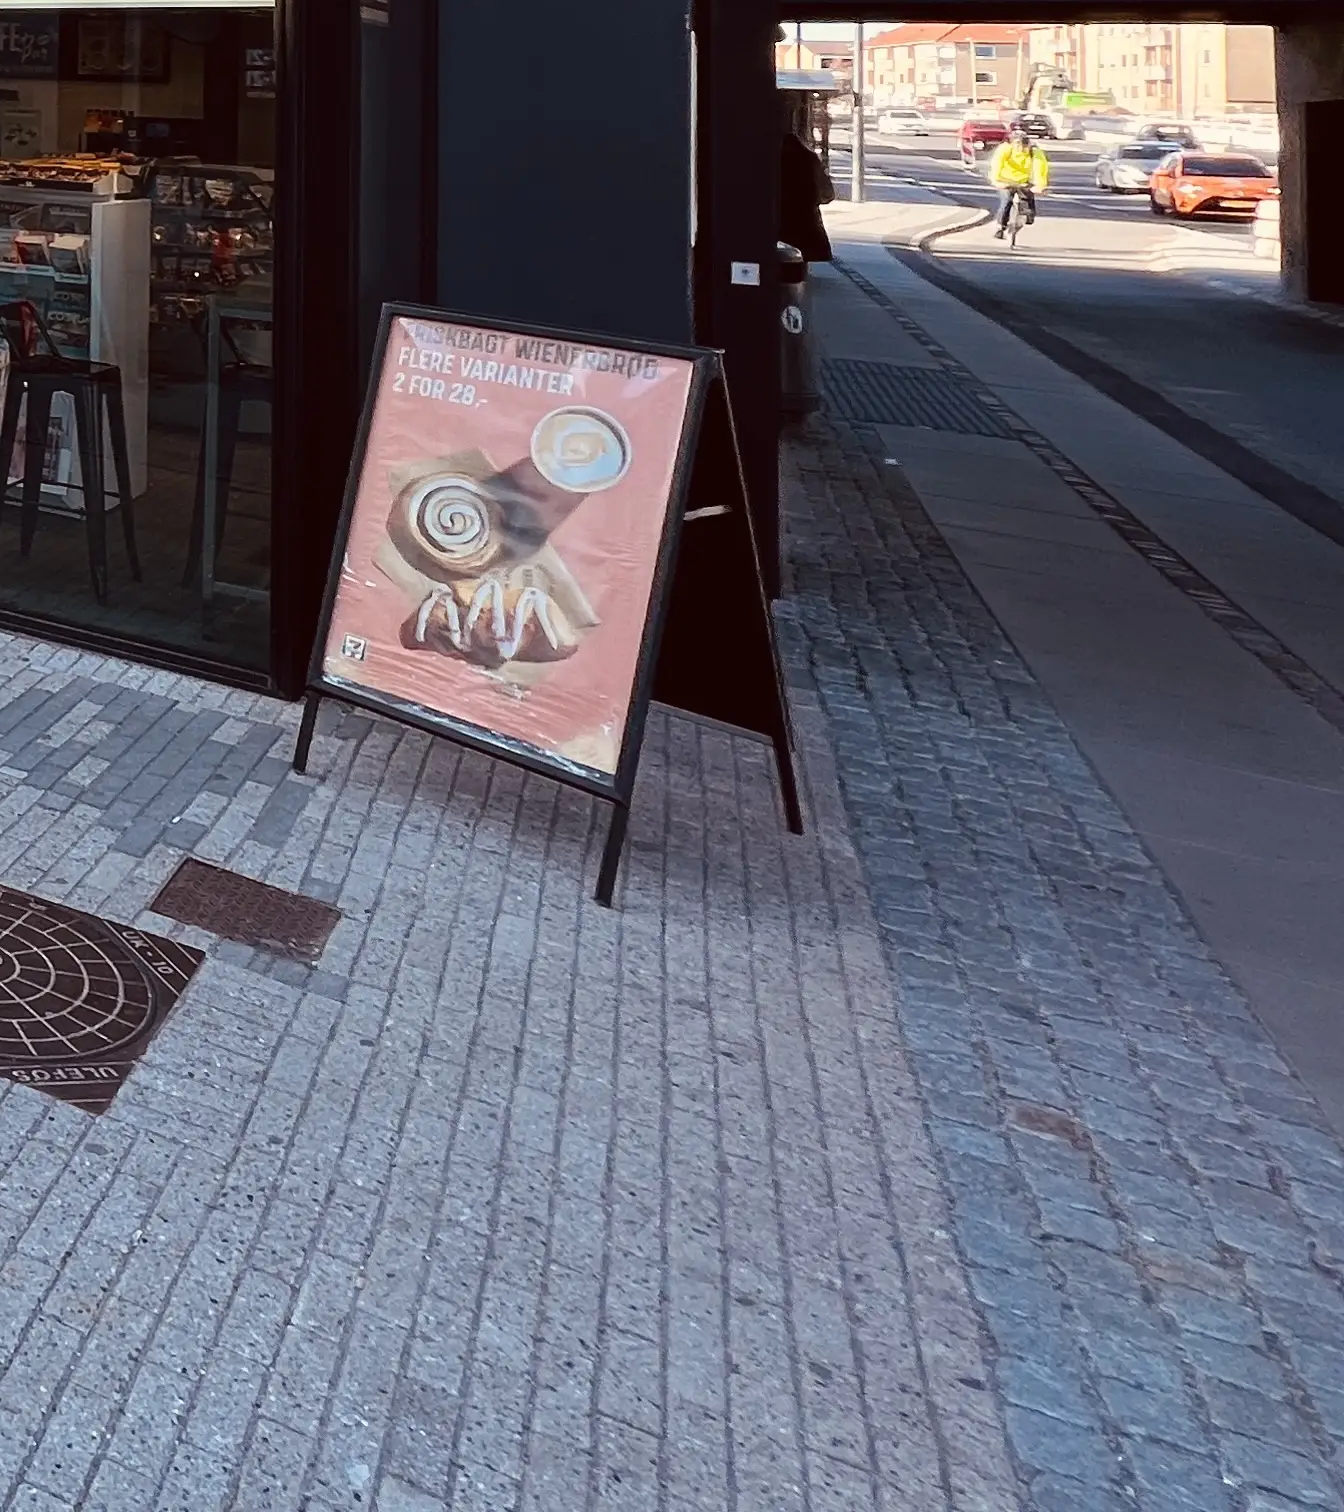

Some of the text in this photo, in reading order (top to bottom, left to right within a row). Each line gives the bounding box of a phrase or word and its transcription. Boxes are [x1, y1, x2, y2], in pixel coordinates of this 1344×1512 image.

[392, 373, 404, 393] 2
[409, 375, 445, 400] FOR
[398, 346, 574, 396] FLERE VARIANTER
